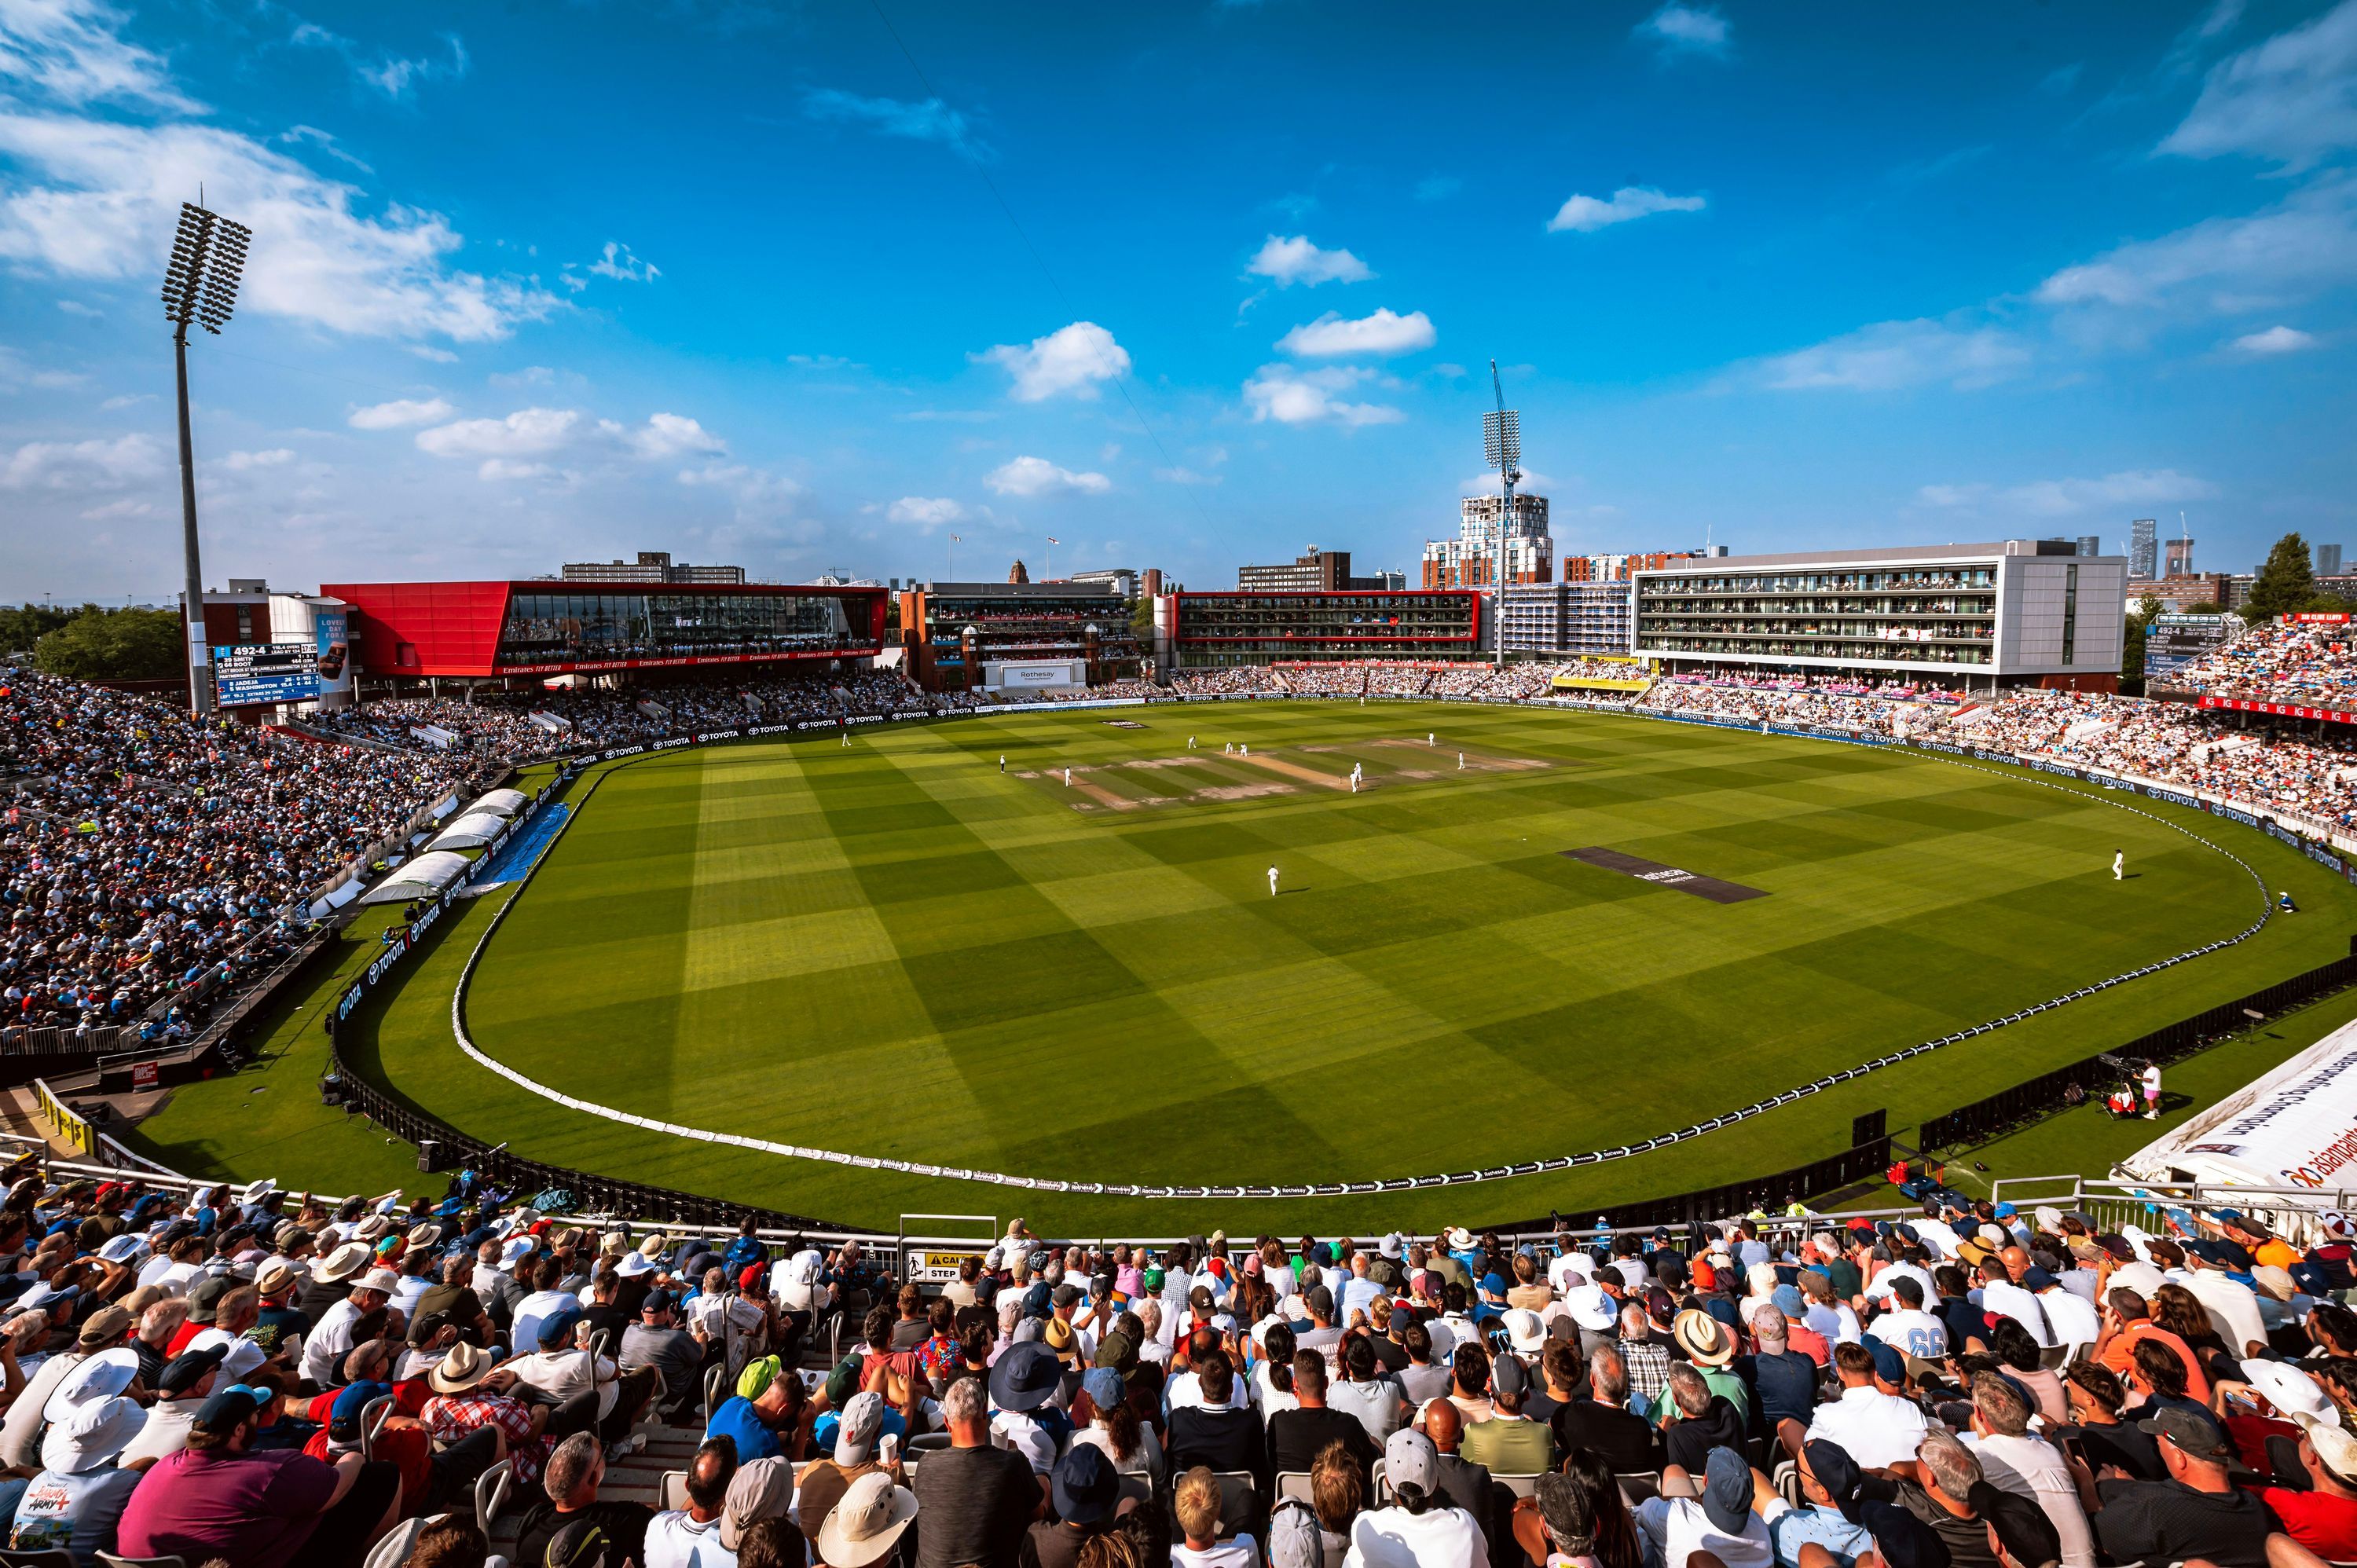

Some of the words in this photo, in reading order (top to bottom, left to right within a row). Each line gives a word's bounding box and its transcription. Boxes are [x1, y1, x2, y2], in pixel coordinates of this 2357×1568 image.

[234, 647, 266, 655] 492-4
[2241, 701, 2250, 709] IG
[2258, 703, 2267, 712] IG
[2277, 705, 2286, 714] IG
[2294, 707, 2304, 716] IG
[2313, 709, 2322, 718] IG
[2332, 712, 2341, 721] IG
[760, 724, 789, 733] TOYOTA
[809, 719, 837, 727] TOYOTA
[1770, 722, 1799, 731] TOYOTA
[709, 731, 739, 740] TOYOTA
[1821, 727, 1851, 738] TOYOTA
[663, 737, 690, 748] TOYOTA
[1875, 735, 1908, 746] TOYOTA
[616, 745, 643, 757] TOYOTA
[1932, 743, 1963, 755] TOYOTA
[1988, 753, 2021, 766] TOYOTA
[2044, 764, 2077, 778] TOYOTA
[2101, 776, 2135, 793] TOYOTA
[2162, 790, 2200, 809] TOYOTA
[2226, 807, 2257, 828] TOYOTA
[496, 833, 508, 851] TOYOTA
[2277, 826, 2299, 848] TOYOTA
[475, 850, 489, 874] TOYOTA
[2315, 848, 2342, 874] TOYOTA
[451, 875, 467, 899] TOYOTA
[419, 903, 440, 933] TOYOTA
[379, 939, 405, 974] TOYOTA
[339, 983, 362, 1020] OYOTA
[2223, 1097, 2305, 1136] Champion
[1908, 1328, 1947, 1357] 66
[28, 1497, 58, 1511] ARMY
